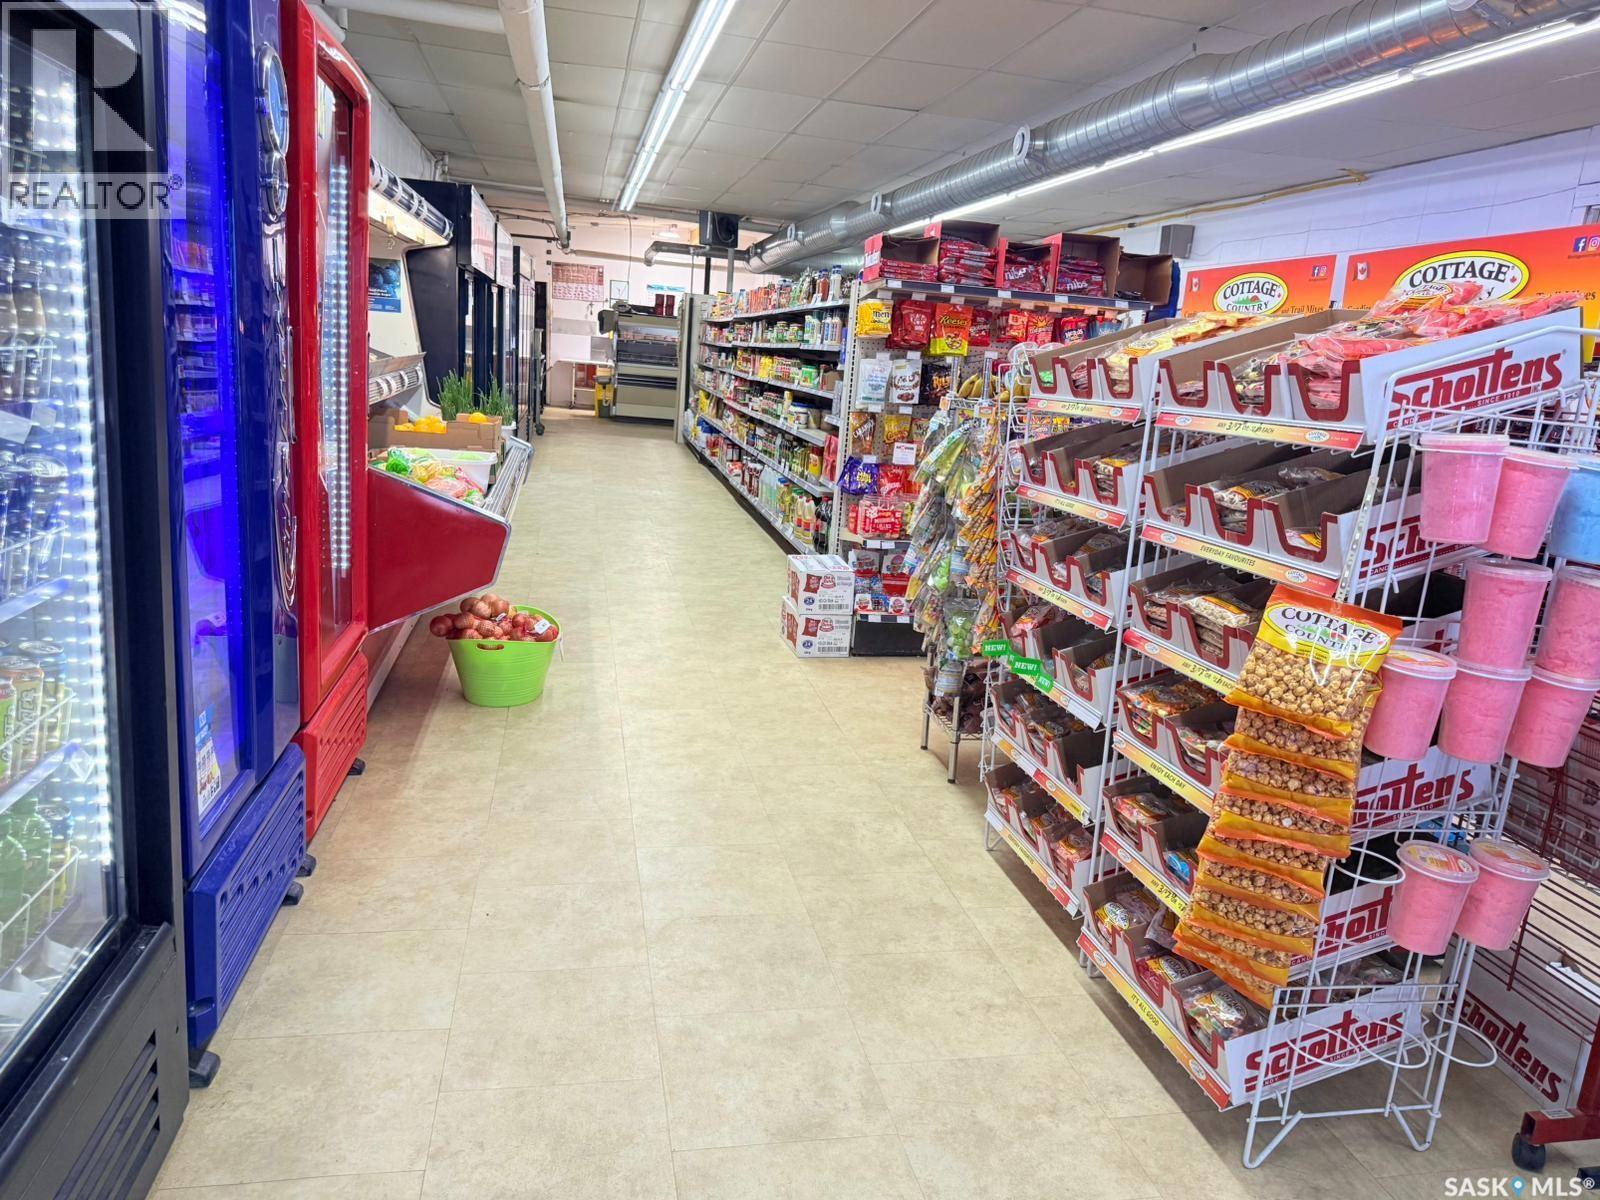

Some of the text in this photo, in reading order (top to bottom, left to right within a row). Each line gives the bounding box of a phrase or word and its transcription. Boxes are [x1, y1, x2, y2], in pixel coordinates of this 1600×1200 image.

[1409, 260, 1509, 289] COTTAGE
[1066, 278, 1088, 291] nibs
[1223, 280, 1277, 300] COTTAGE
[1226, 301, 1269, 313] COUNTRY
[1291, 304, 1305, 314] Trail
[1306, 304, 1324, 313] Mixes
[1477, 390, 1520, 406] SINCE 1910
[1200, 545, 1256, 567] EVERYDAY FAVOURITES
[1281, 607, 1378, 644] COTTAGE
[984, 644, 1006, 652] NEW!
[1014, 661, 1037, 671] NEW!
[1150, 762, 1186, 789] ENJOY EACH DAY
[1131, 993, 1160, 1026] IT'S ALL GOOD
